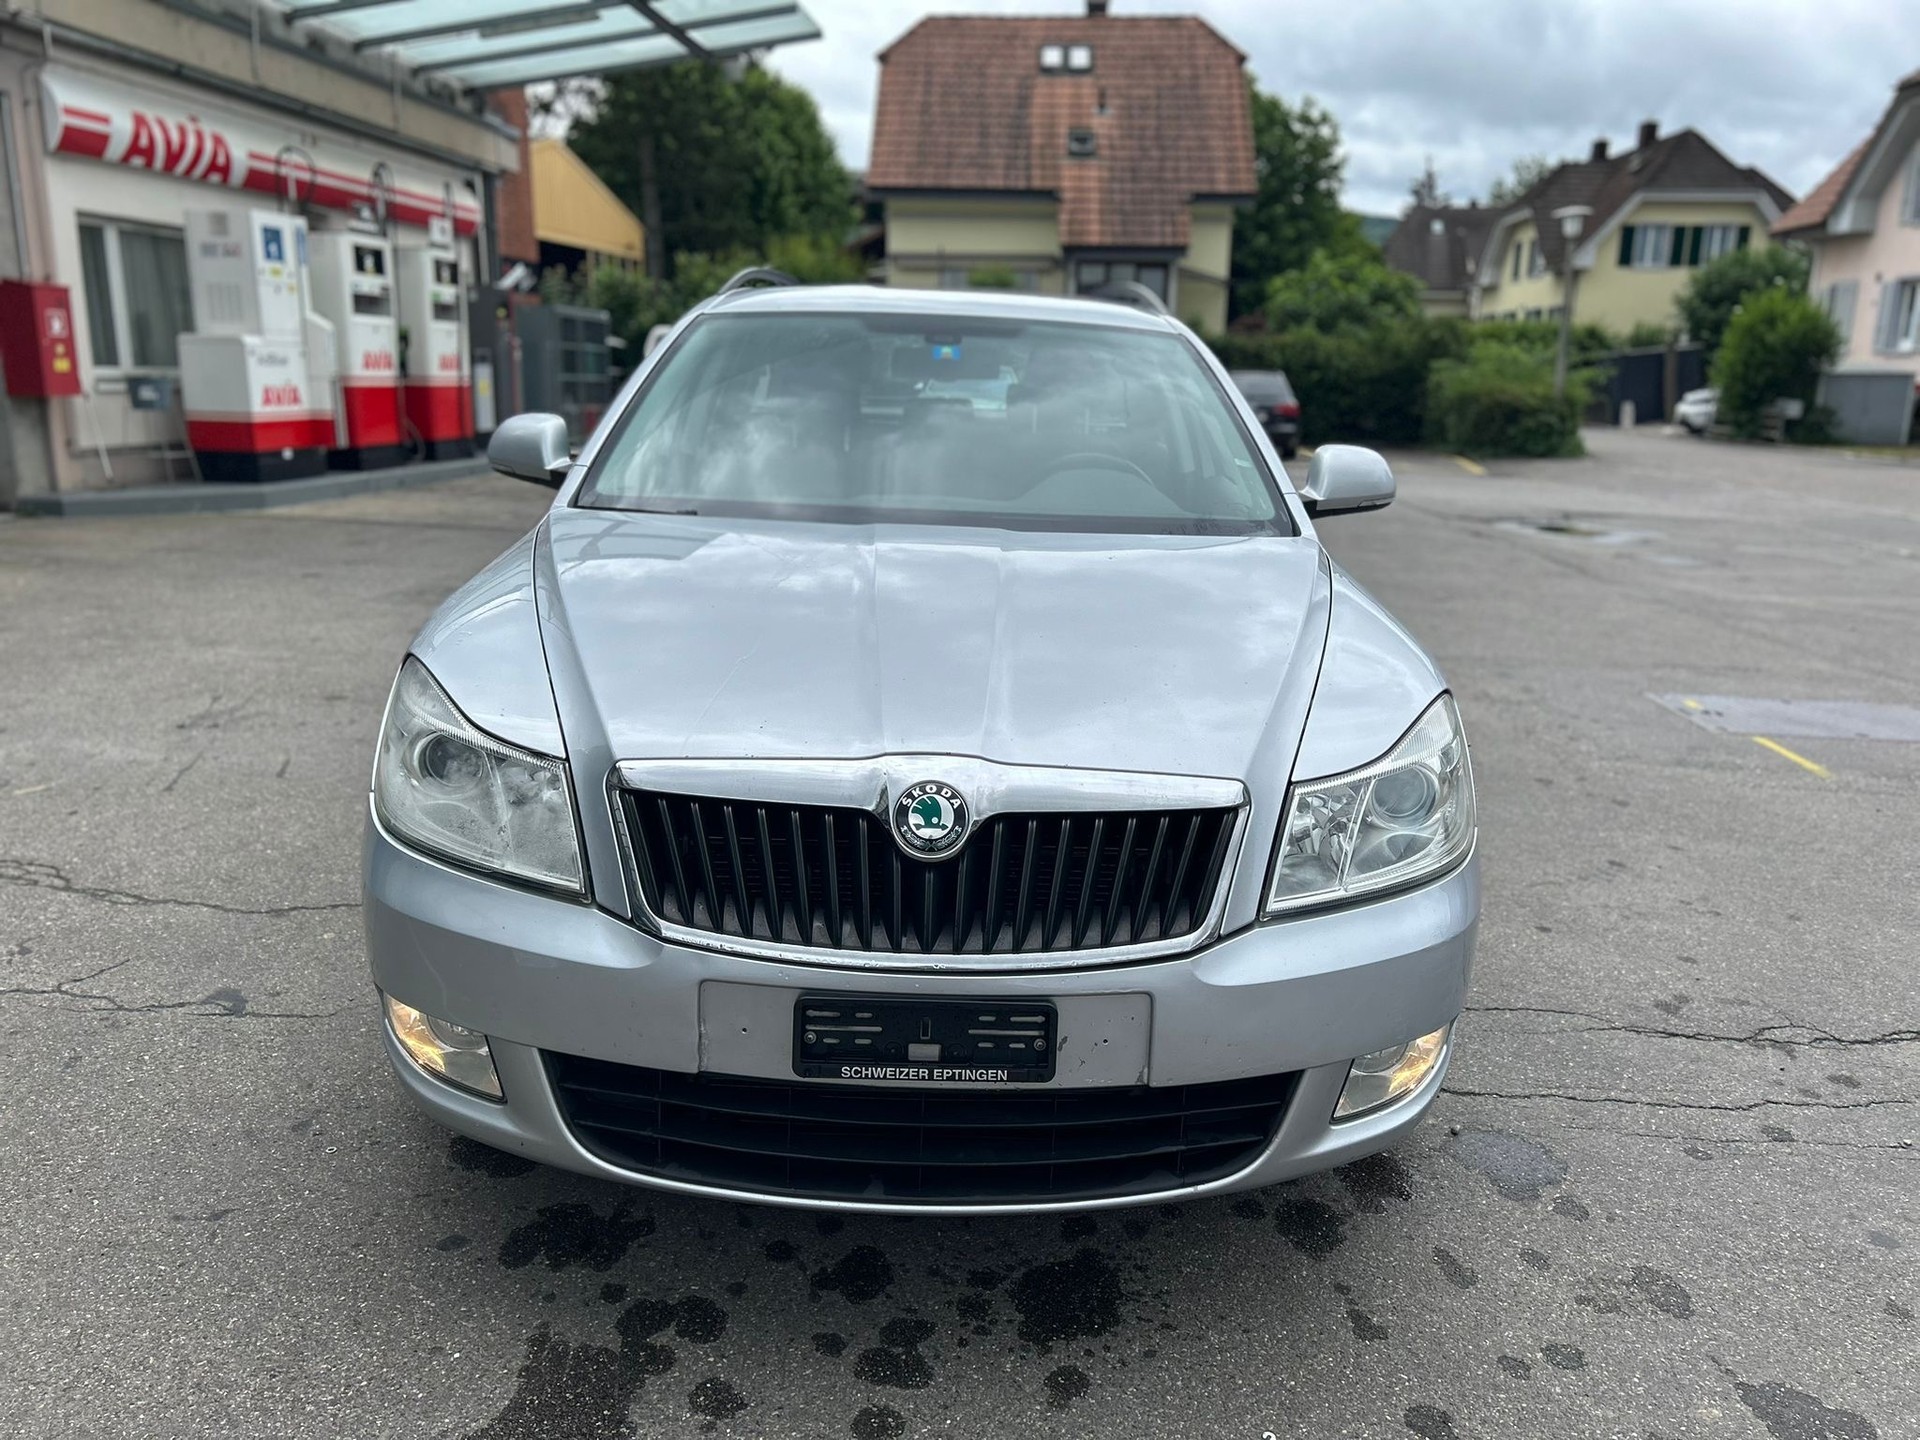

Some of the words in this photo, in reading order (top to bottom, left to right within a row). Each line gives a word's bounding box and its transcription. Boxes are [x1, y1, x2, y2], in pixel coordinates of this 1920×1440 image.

[121, 111, 232, 183] AVIA
[262, 381, 302, 406] AVIA
[902, 785, 961, 808] SKODA
[841, 1066, 929, 1080] SCHWEIZER
[933, 1069, 1008, 1081] EPTINGEN
